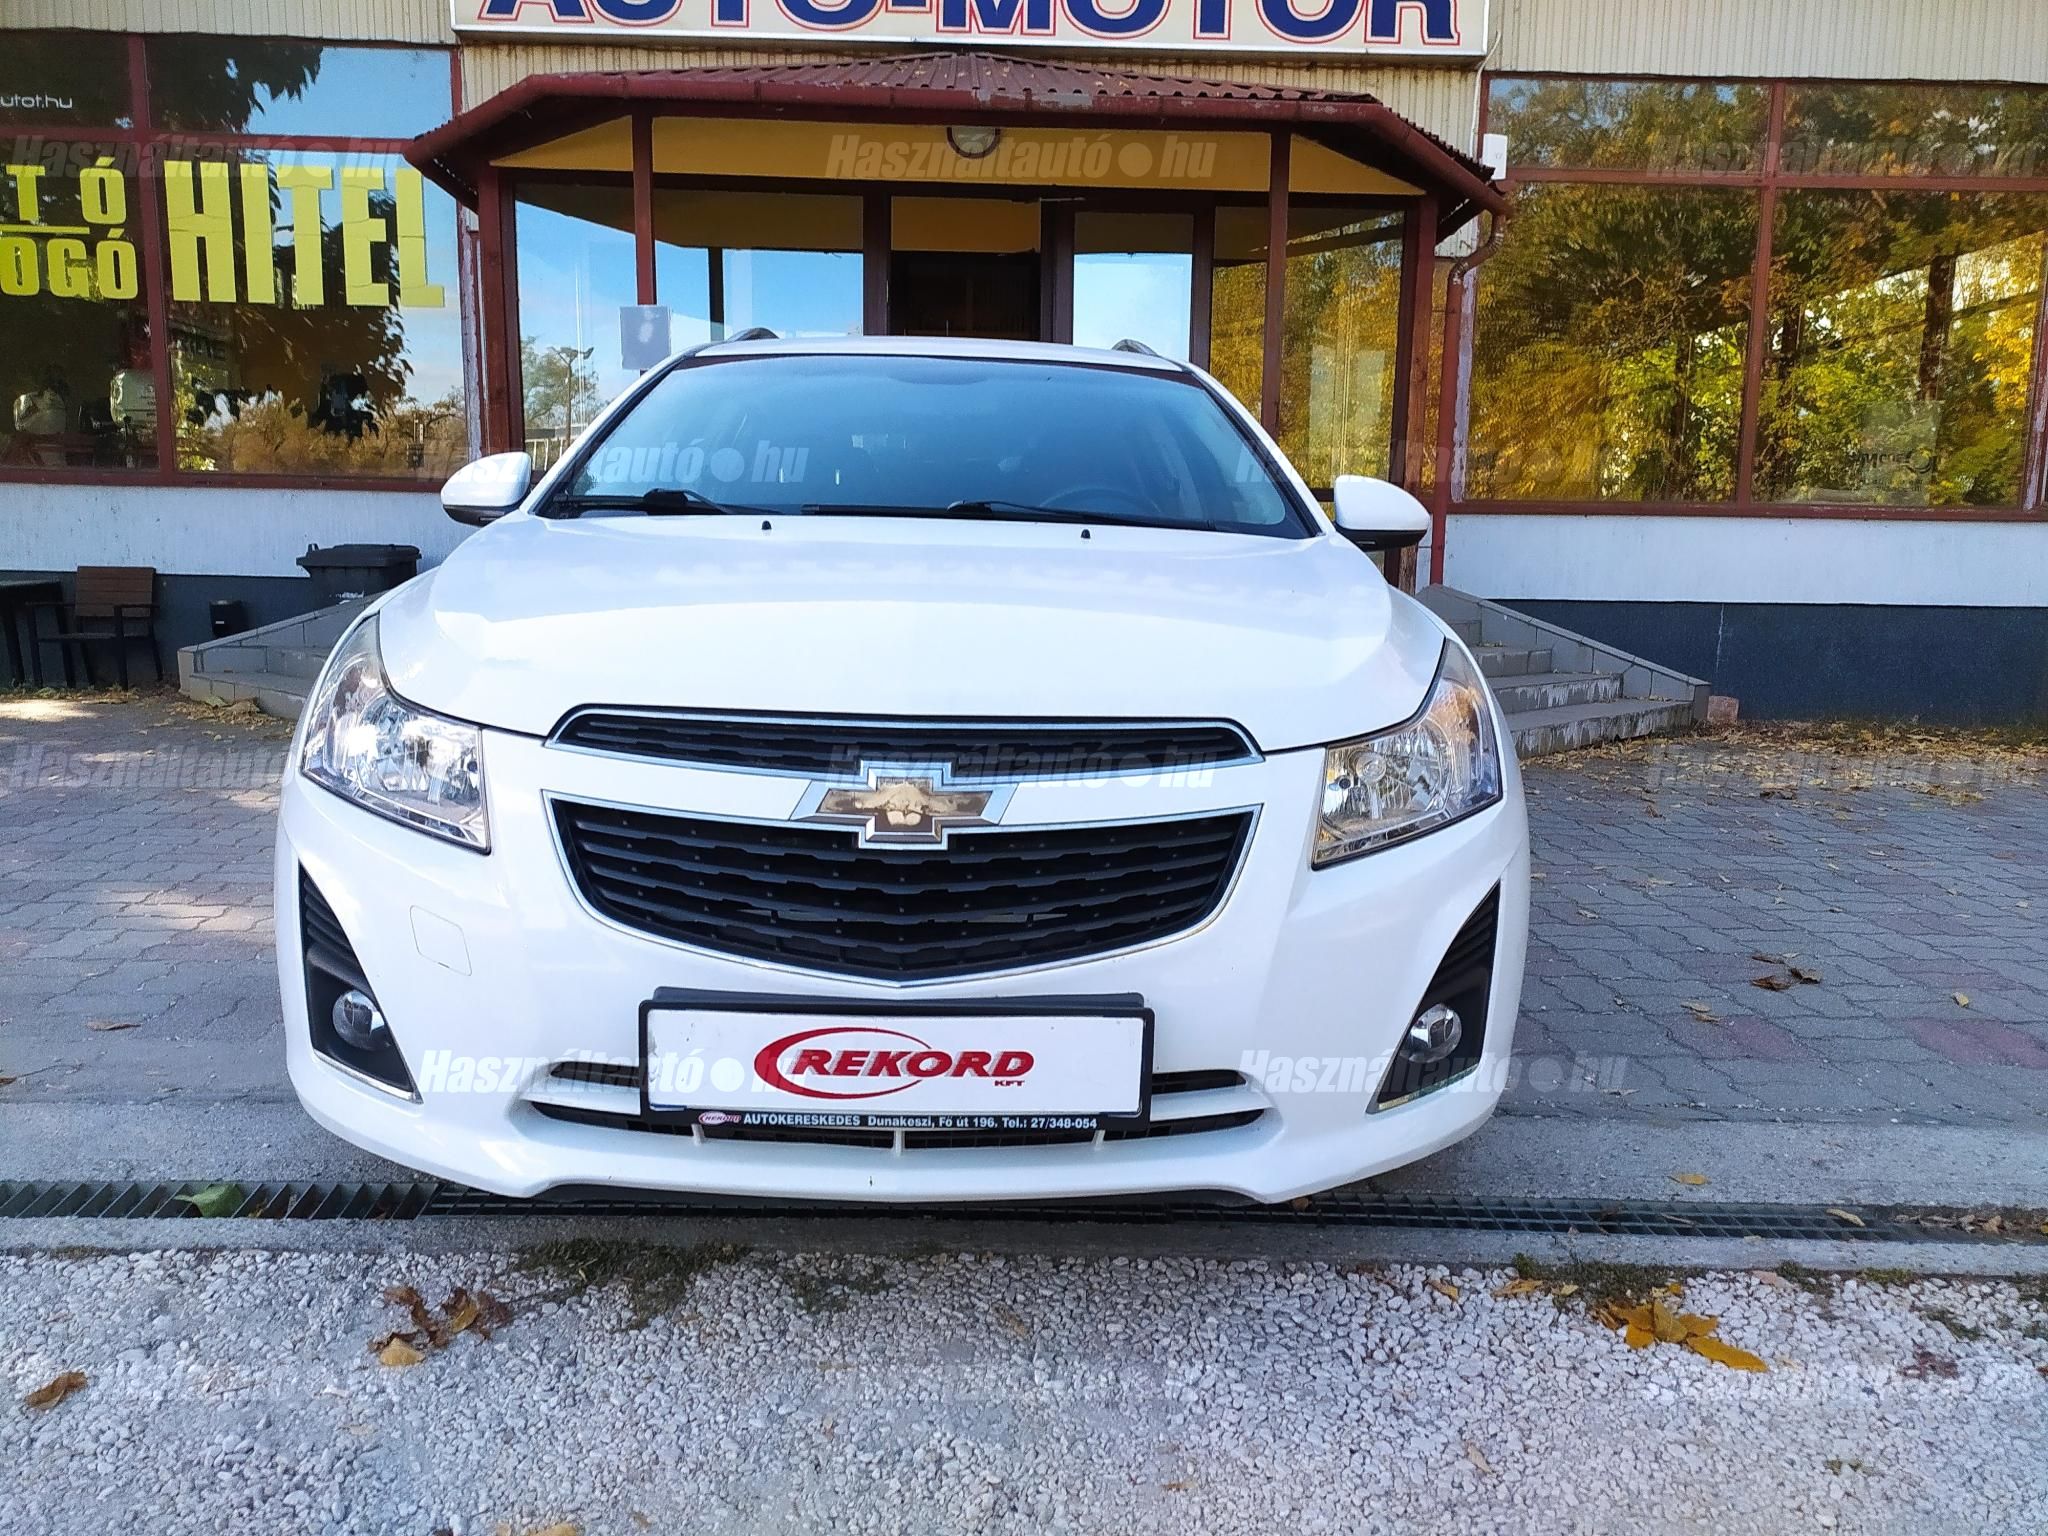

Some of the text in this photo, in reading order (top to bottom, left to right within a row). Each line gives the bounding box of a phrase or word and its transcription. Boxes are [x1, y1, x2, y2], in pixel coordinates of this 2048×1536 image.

[164, 160, 445, 307] HITEL
[788, 1049, 1035, 1077] REKORD
[994, 1079, 1026, 1087] KFT
[956, 1115, 969, 1127] út
[1030, 1117, 1098, 1129] 27/348-054
